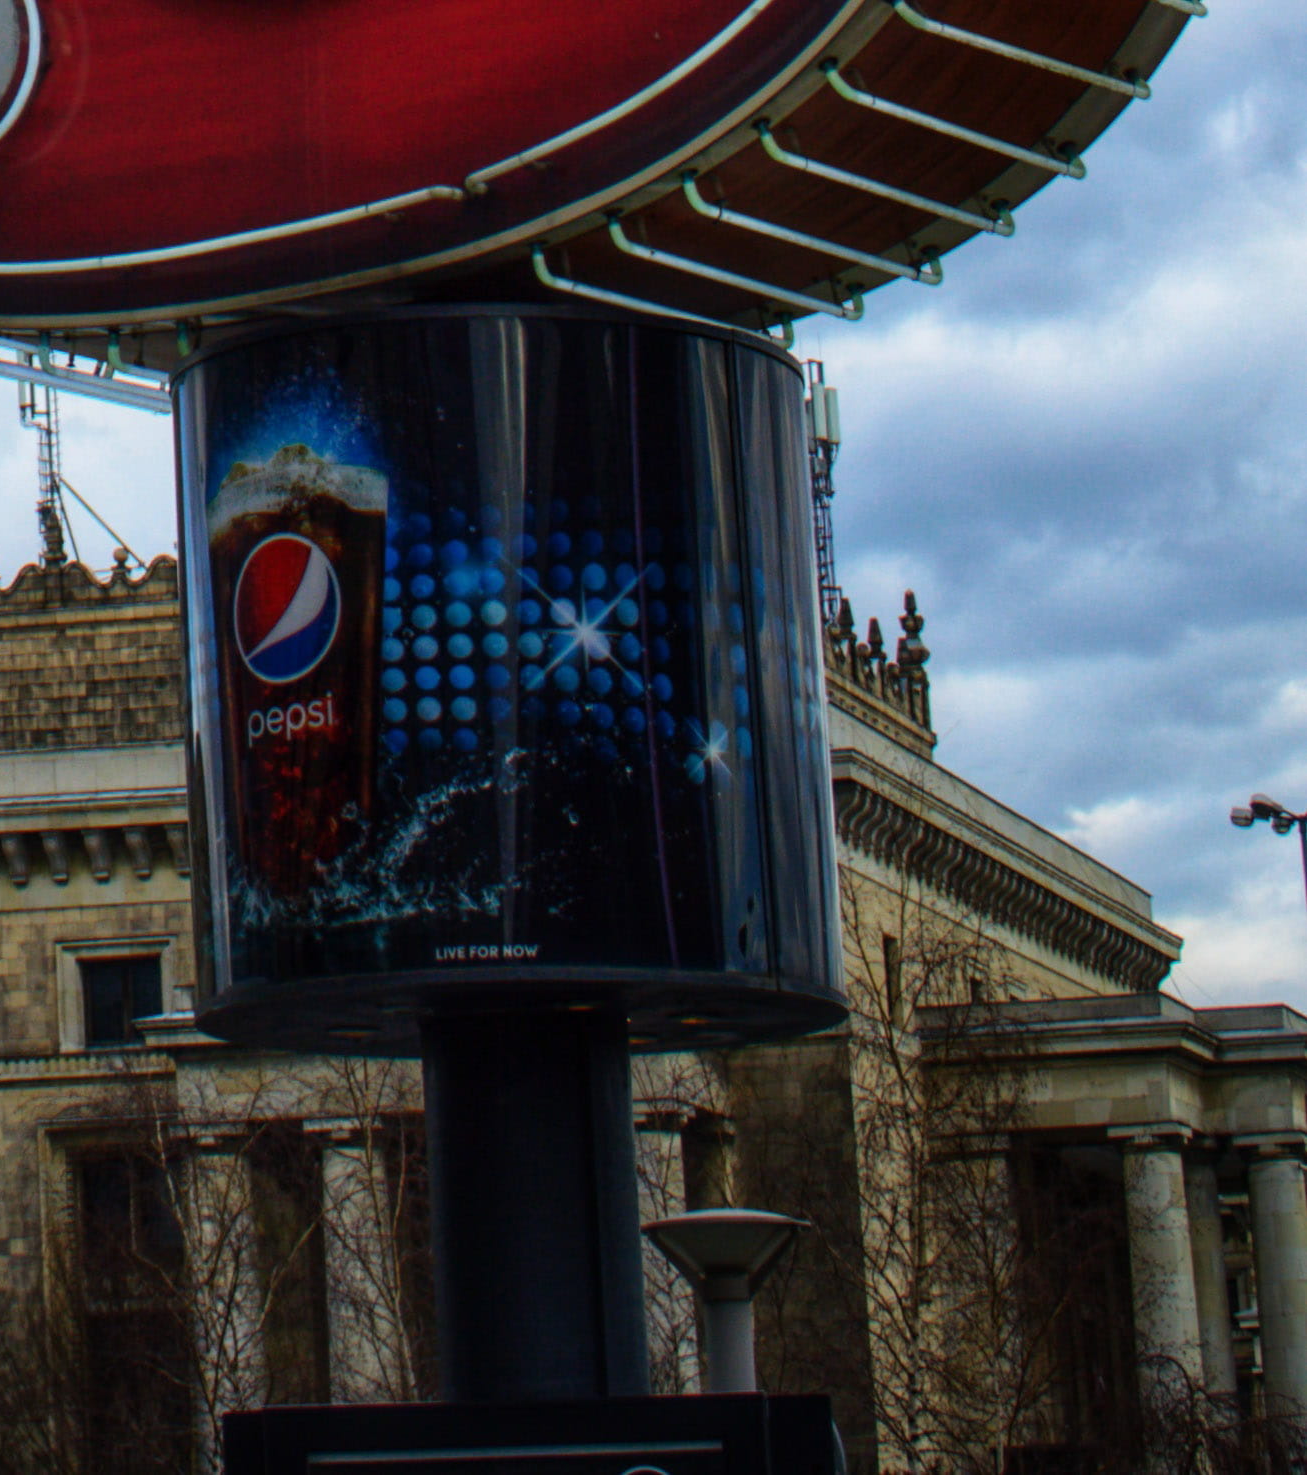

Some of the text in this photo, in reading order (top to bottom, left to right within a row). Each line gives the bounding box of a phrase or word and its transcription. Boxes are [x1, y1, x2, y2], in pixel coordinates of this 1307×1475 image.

[247, 690, 334, 748] pepsi
[435, 944, 539, 960] LIVE FOR NOW
